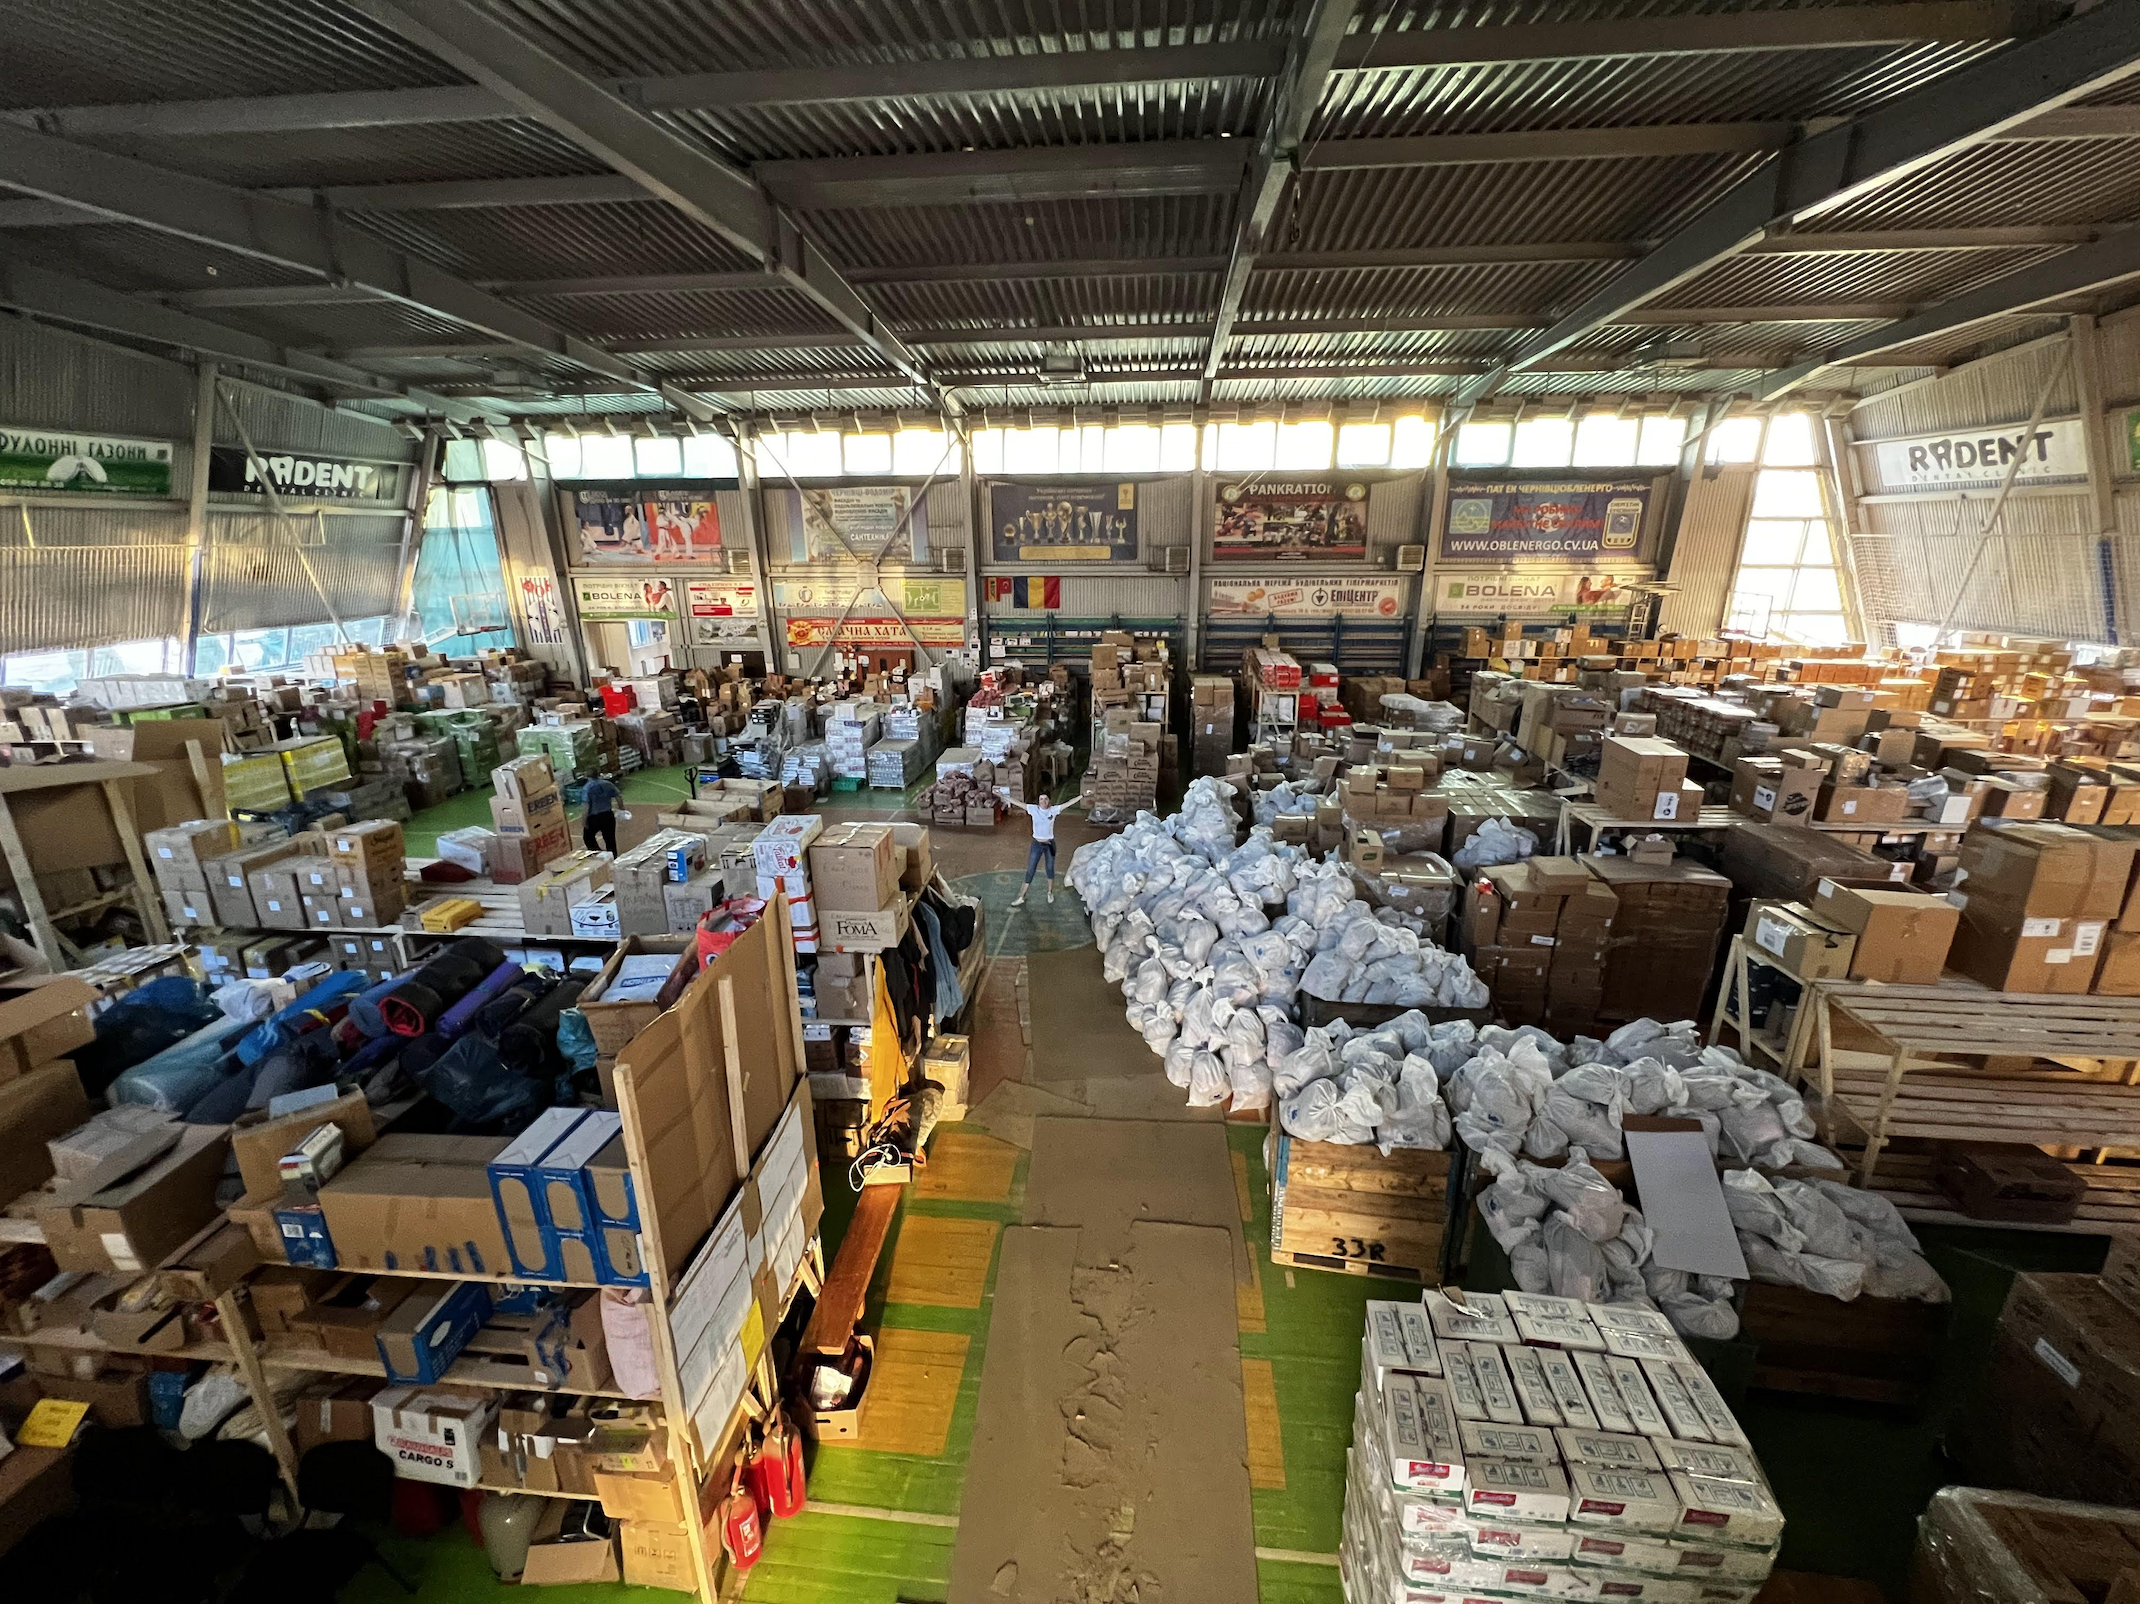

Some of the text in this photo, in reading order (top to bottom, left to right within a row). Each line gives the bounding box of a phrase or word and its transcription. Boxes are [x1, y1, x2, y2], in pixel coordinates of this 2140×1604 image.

[1983, 465, 2051, 479] CLNIC
[243, 484, 307, 496] DETAL
[1451, 539, 1599, 552] WWW.OBLENERGO.CV.UA
[592, 592, 642, 600] BOLENA
[1330, 589, 1379, 602] ЕПІЦЕНТР
[1465, 585, 1556, 597] BOLENA
[874, 626, 907, 637] ХАТА
[837, 921, 877, 936] FOMA
[1331, 1237, 1386, 1261] 33R
[399, 1450, 454, 1469] CARGO S
